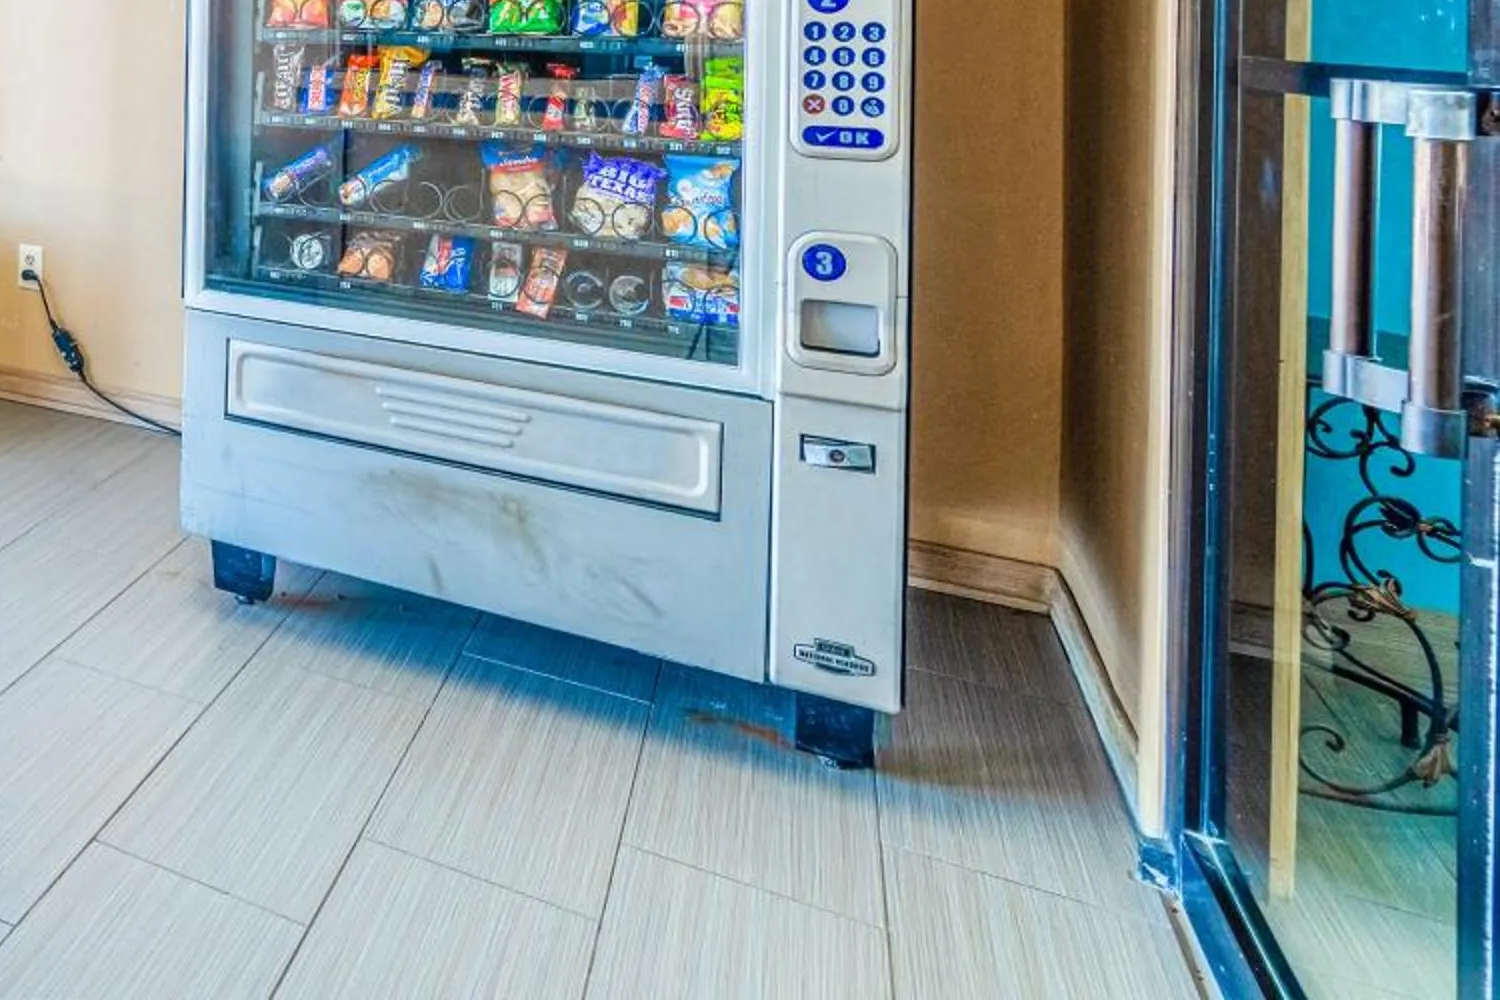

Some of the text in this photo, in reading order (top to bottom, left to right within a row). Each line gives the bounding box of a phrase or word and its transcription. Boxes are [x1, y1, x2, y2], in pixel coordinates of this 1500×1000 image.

[811, 25, 879, 40] 1 2 3
[809, 50, 878, 64] 4 5 6
[810, 74, 878, 90] 7 8 9
[839, 99, 848, 112] 0
[839, 130, 870, 145] OK
[600, 165, 646, 189] BIG
[590, 172, 655, 201] TEXAS
[815, 251, 833, 275] 3
